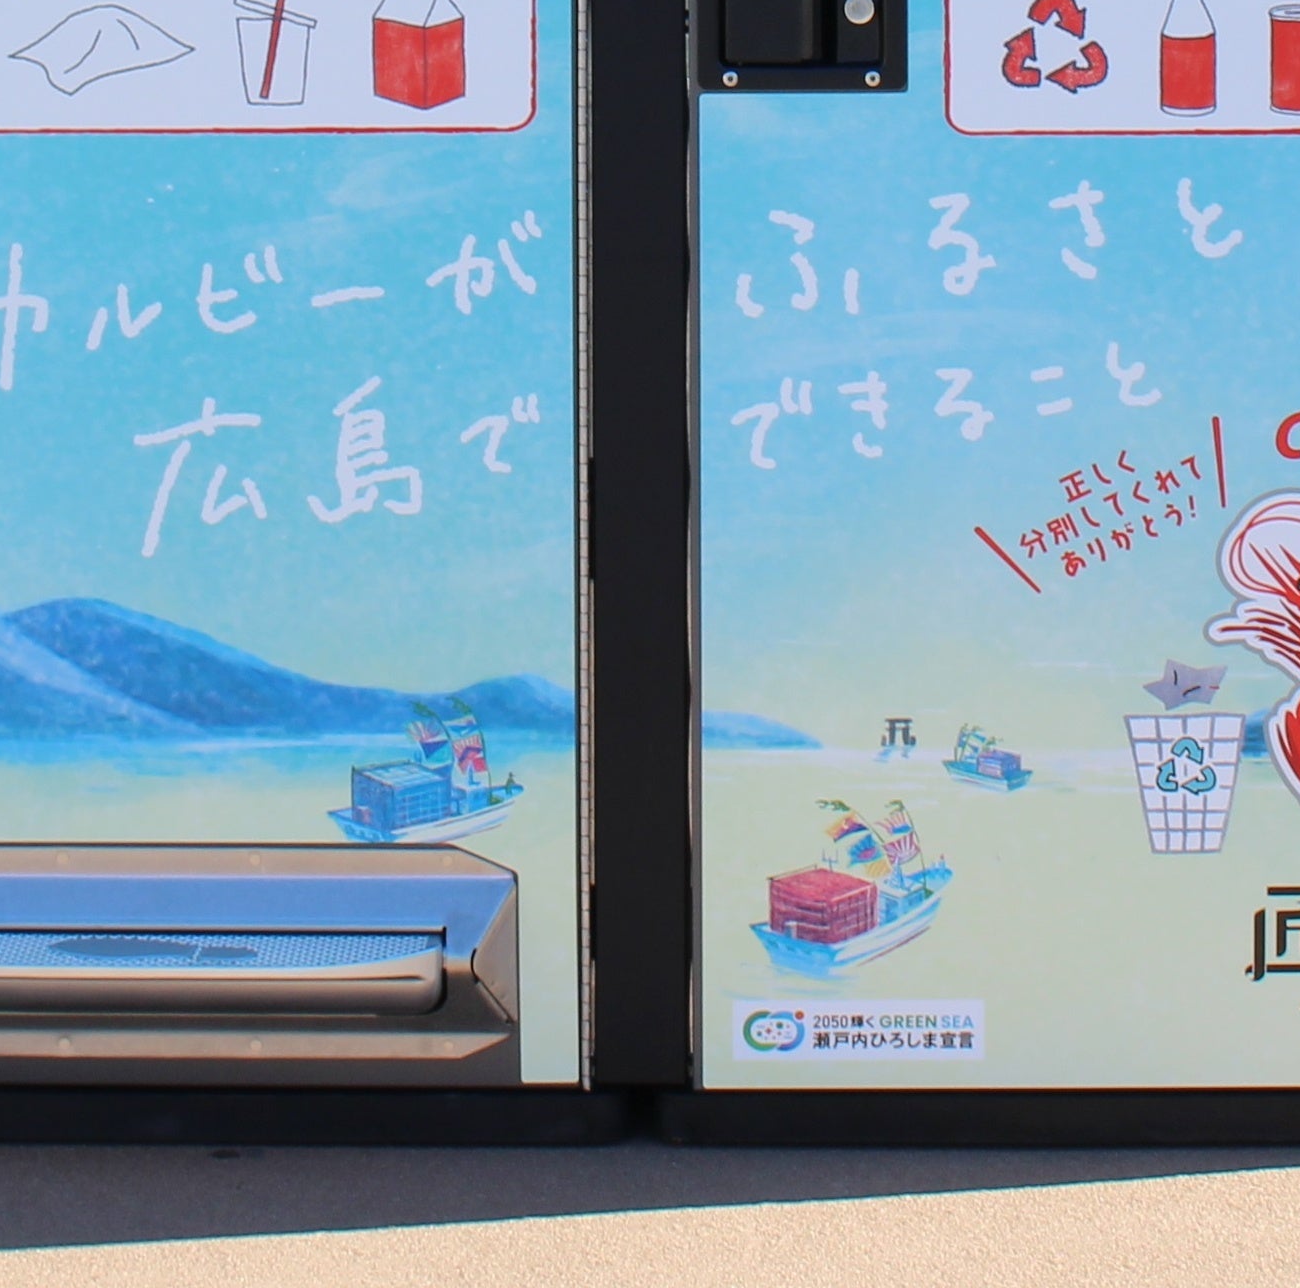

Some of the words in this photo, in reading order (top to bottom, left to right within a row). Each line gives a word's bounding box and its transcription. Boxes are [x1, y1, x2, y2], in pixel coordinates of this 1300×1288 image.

[735, 176, 1244, 318] ふるさと
[133, 375, 540, 557] 広島で
[730, 341, 1163, 470] できること
[1058, 449, 1136, 504] 正しく
[1018, 454, 1202, 559] 分別してくれて
[812, 1031, 975, 1050] 瀬戸内ひろしま宣言
[879, 1014, 938, 1029] GREEN
[941, 1014, 974, 1029] SEA
